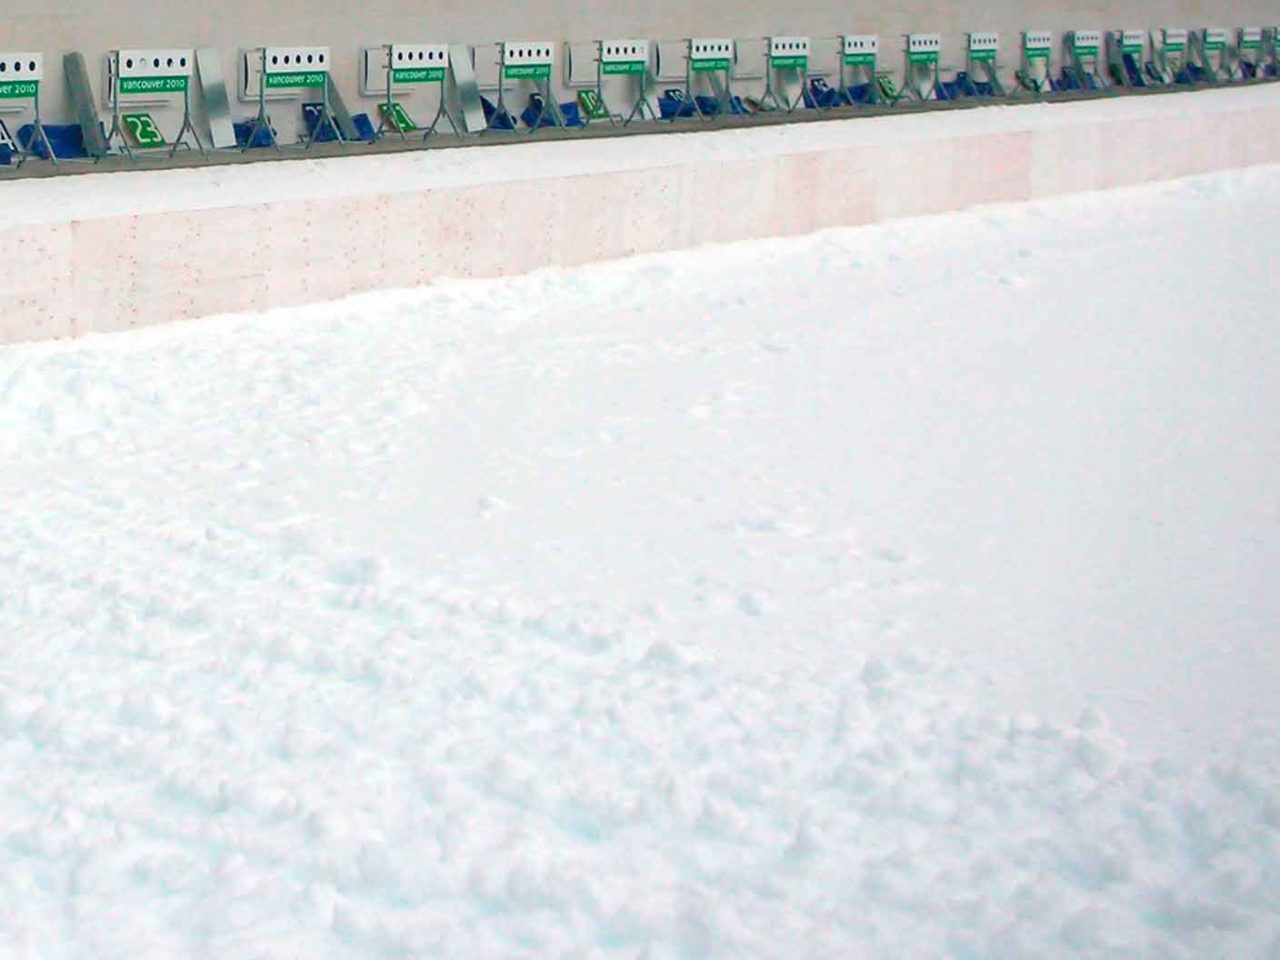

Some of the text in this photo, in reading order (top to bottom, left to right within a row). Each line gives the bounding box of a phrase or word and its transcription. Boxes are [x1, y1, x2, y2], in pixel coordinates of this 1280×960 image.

[14, 84, 36, 94] 2010
[123, 79, 186, 89] vancouver 2010
[126, 116, 161, 143] 23
